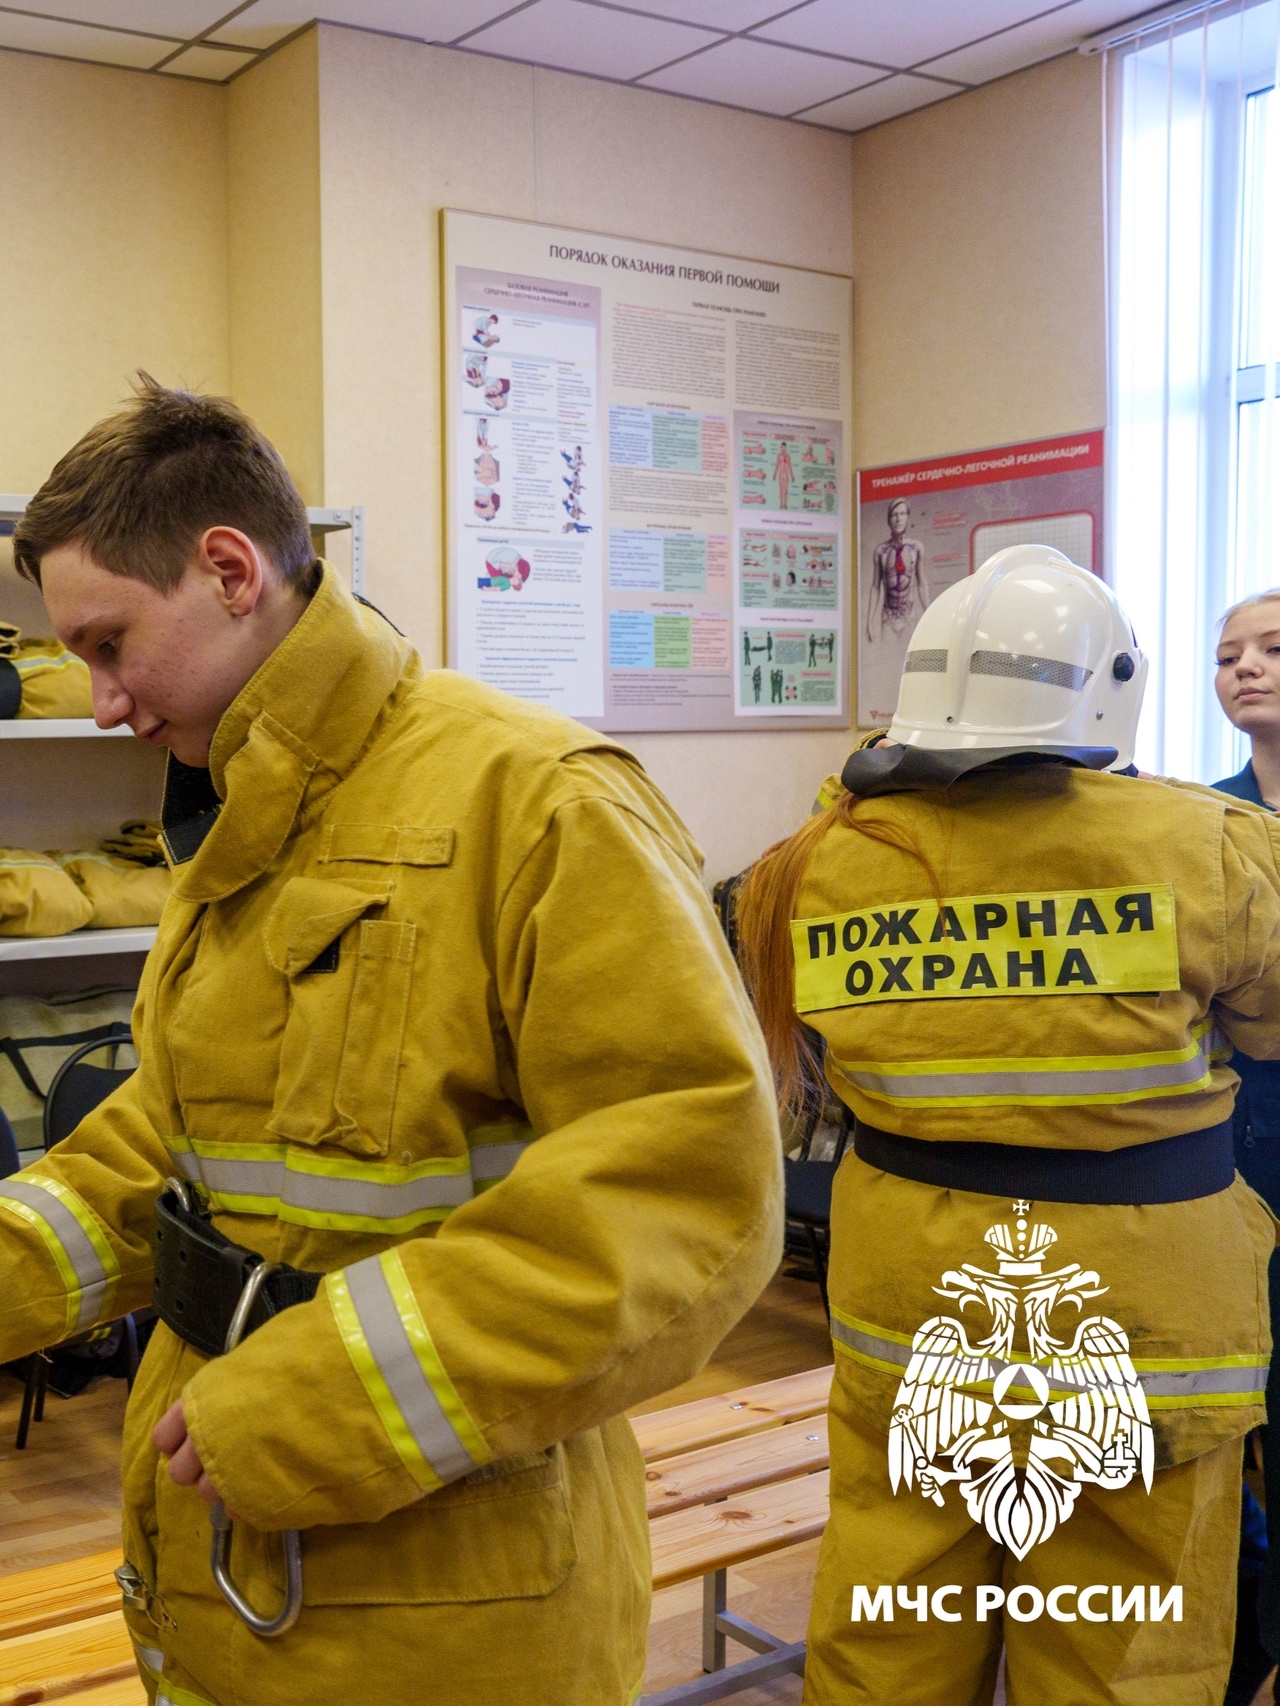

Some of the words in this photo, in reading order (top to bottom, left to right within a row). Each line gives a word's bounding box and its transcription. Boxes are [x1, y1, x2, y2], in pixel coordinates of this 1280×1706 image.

[549, 245, 608, 267] ПОРЯДОК
[611, 256, 675, 278] ОКАЗАНИЯ
[678, 266, 723, 284] ПЕРВОЙ
[726, 274, 780, 294] ПОМОЩИ
[807, 892, 1155, 960] ПОЖАРНАЯ
[845, 948, 1098, 997] ОХРАНА
